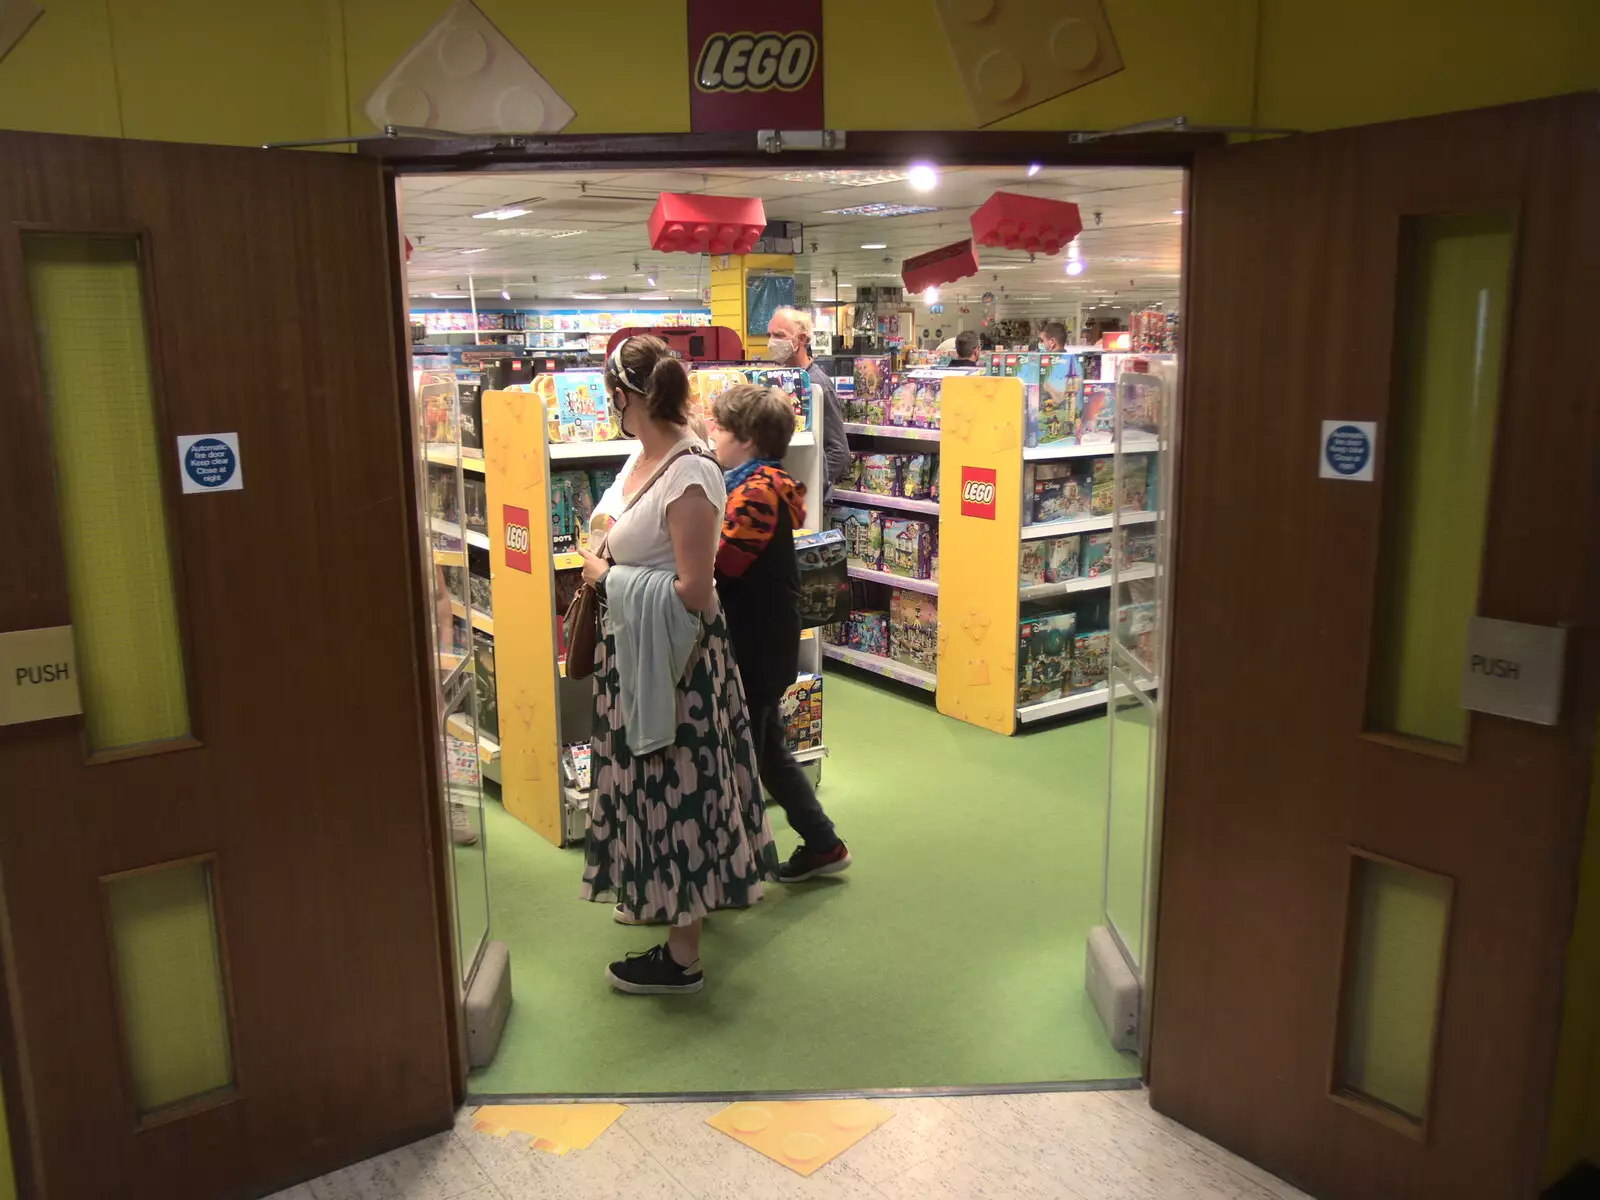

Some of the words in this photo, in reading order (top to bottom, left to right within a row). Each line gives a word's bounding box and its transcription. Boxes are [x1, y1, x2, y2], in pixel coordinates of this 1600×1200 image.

[698, 34, 816, 90] LEGO
[190, 459, 210, 467] Keep
[963, 480, 995, 504] LEGO
[506, 523, 529, 554] LEGO
[553, 535, 572, 543] DOTS
[16, 662, 69, 686] PUSH
[1471, 654, 1520, 680] PUSH
